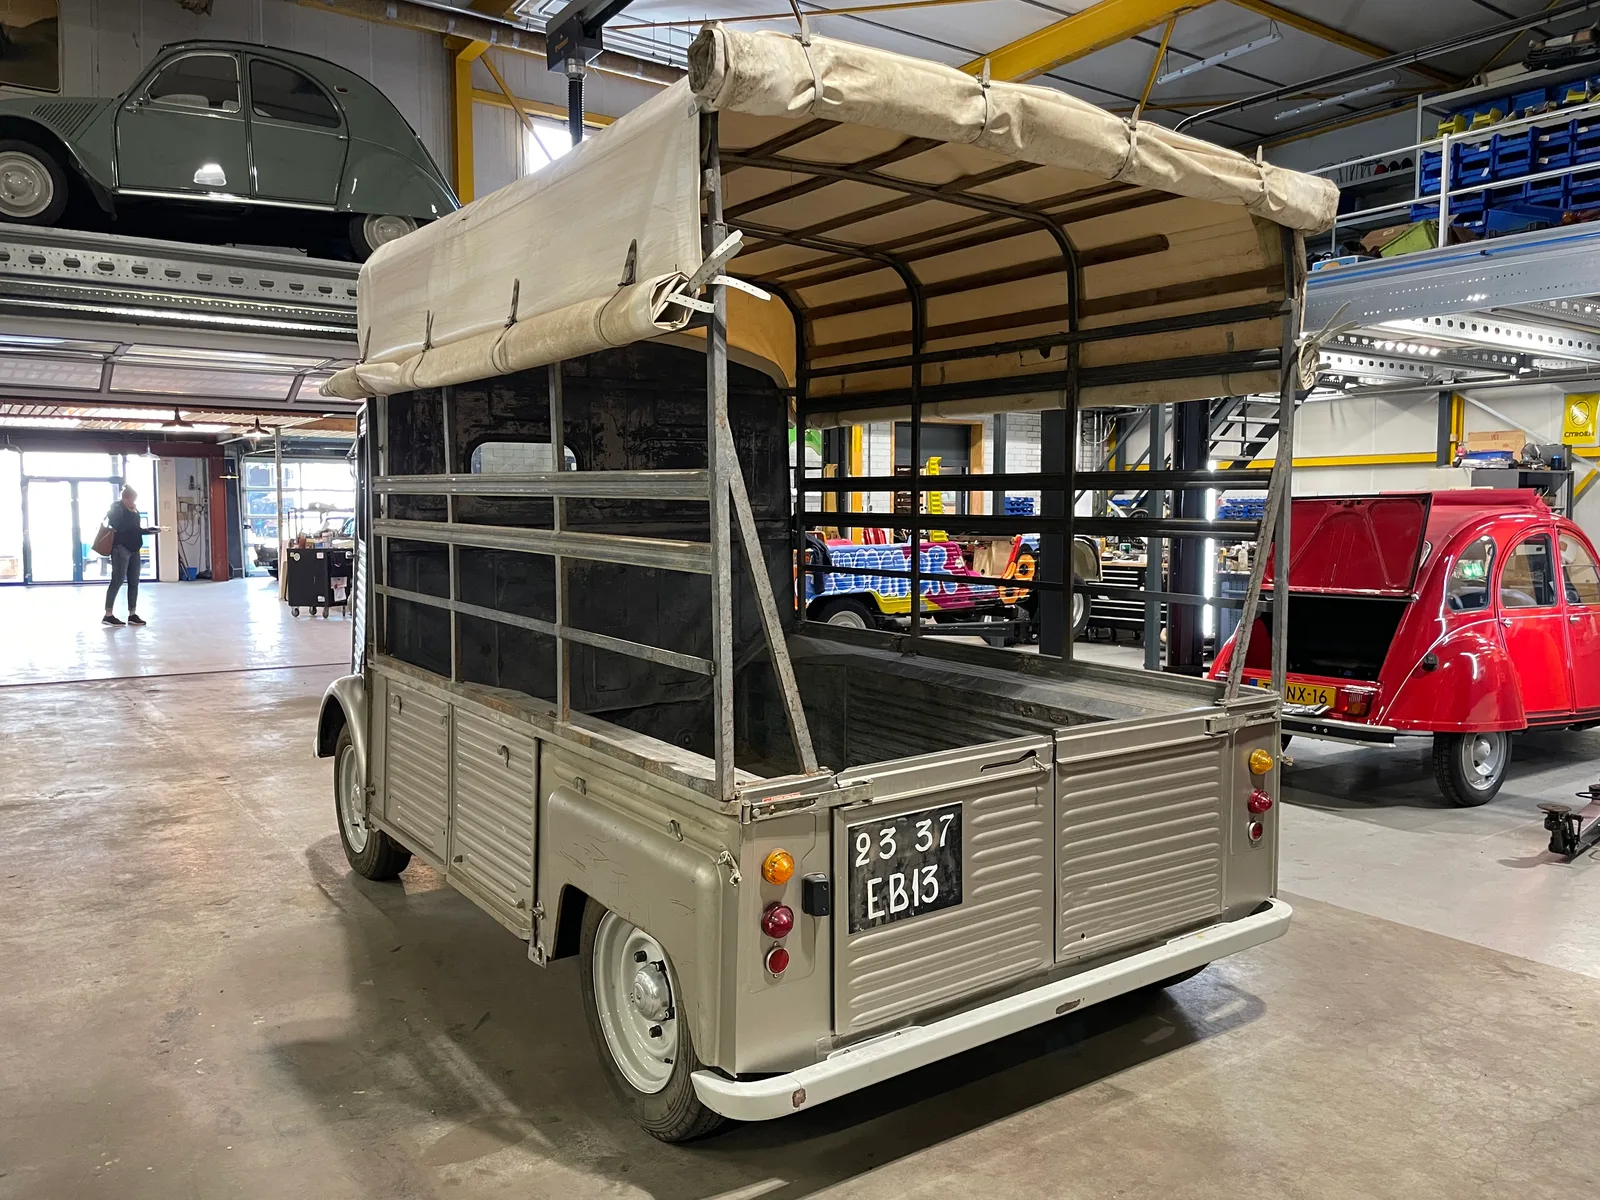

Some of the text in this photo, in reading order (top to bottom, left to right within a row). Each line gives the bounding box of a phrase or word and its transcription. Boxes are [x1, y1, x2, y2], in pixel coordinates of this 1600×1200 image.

[855, 813, 955, 868] 23 37
[867, 863, 939, 920] EB13
